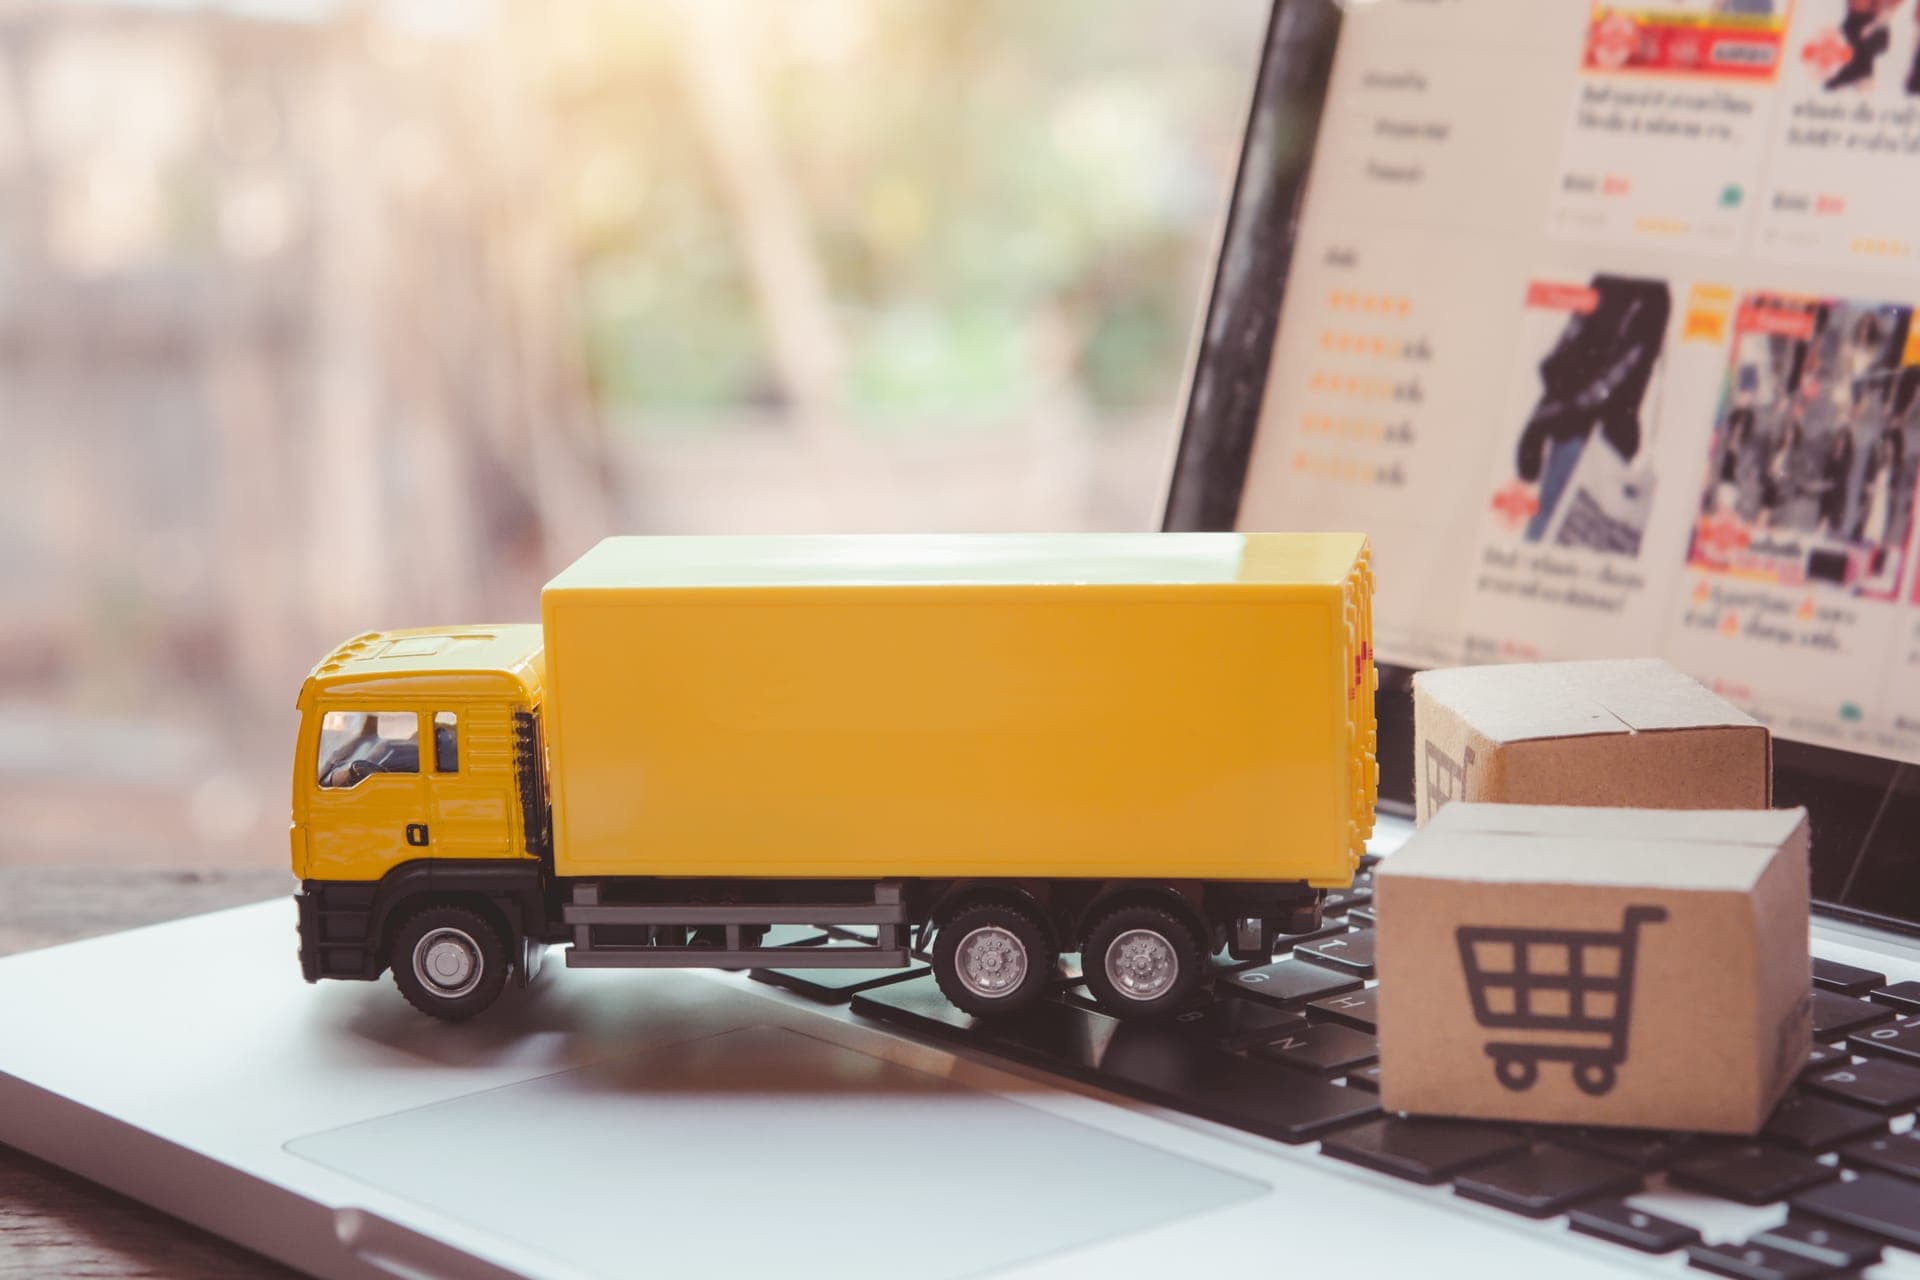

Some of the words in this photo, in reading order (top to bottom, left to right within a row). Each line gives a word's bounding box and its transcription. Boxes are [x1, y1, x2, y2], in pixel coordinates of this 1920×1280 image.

[1318, 939, 1348, 951] T
[1238, 973, 1270, 983] G
[1328, 997, 1366, 1009] H
[1268, 1037, 1307, 1050] N
[1823, 1071, 1857, 1083] P
